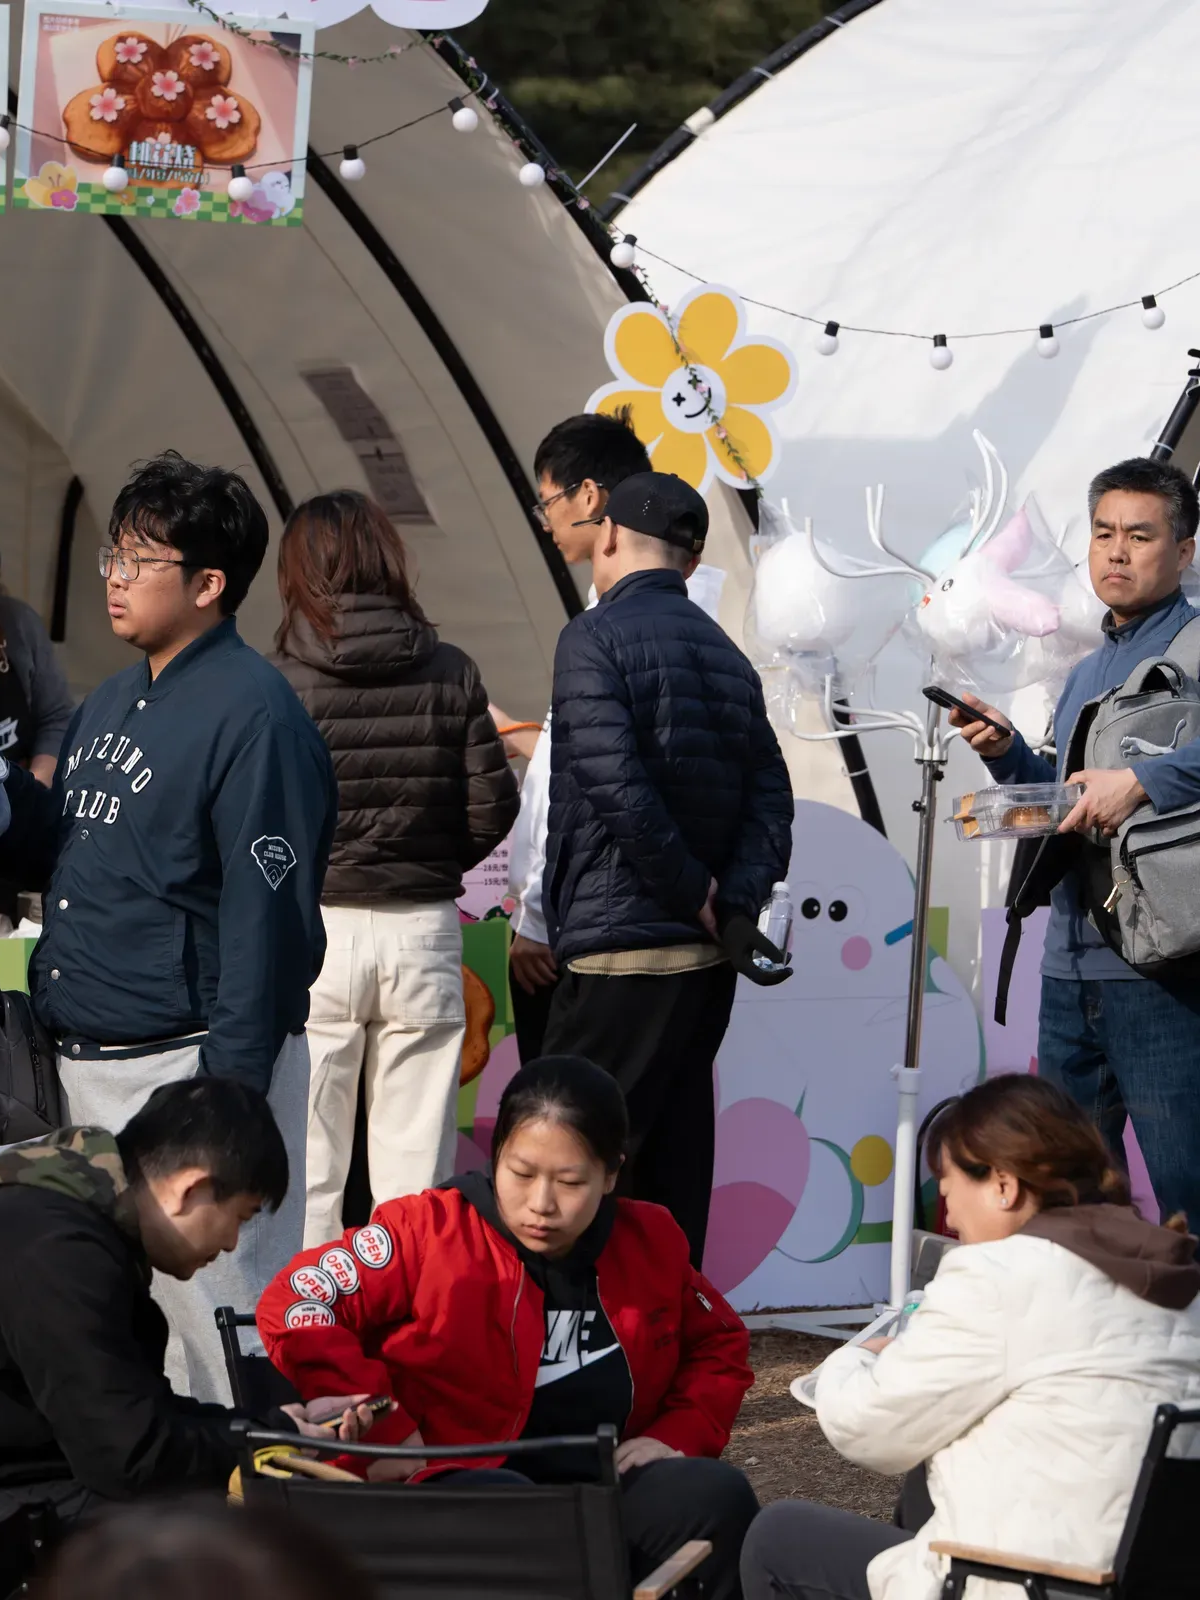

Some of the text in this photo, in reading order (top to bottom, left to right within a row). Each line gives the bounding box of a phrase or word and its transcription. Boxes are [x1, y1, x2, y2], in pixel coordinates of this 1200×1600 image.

[64, 732, 154, 794] MIZUNO
[62, 789, 121, 825] CLUB
[360, 1229, 384, 1263] OPEN
[296, 1272, 332, 1303] OPEN
[326, 1254, 353, 1289] OPEN
[291, 1313, 330, 1327] OPEN
